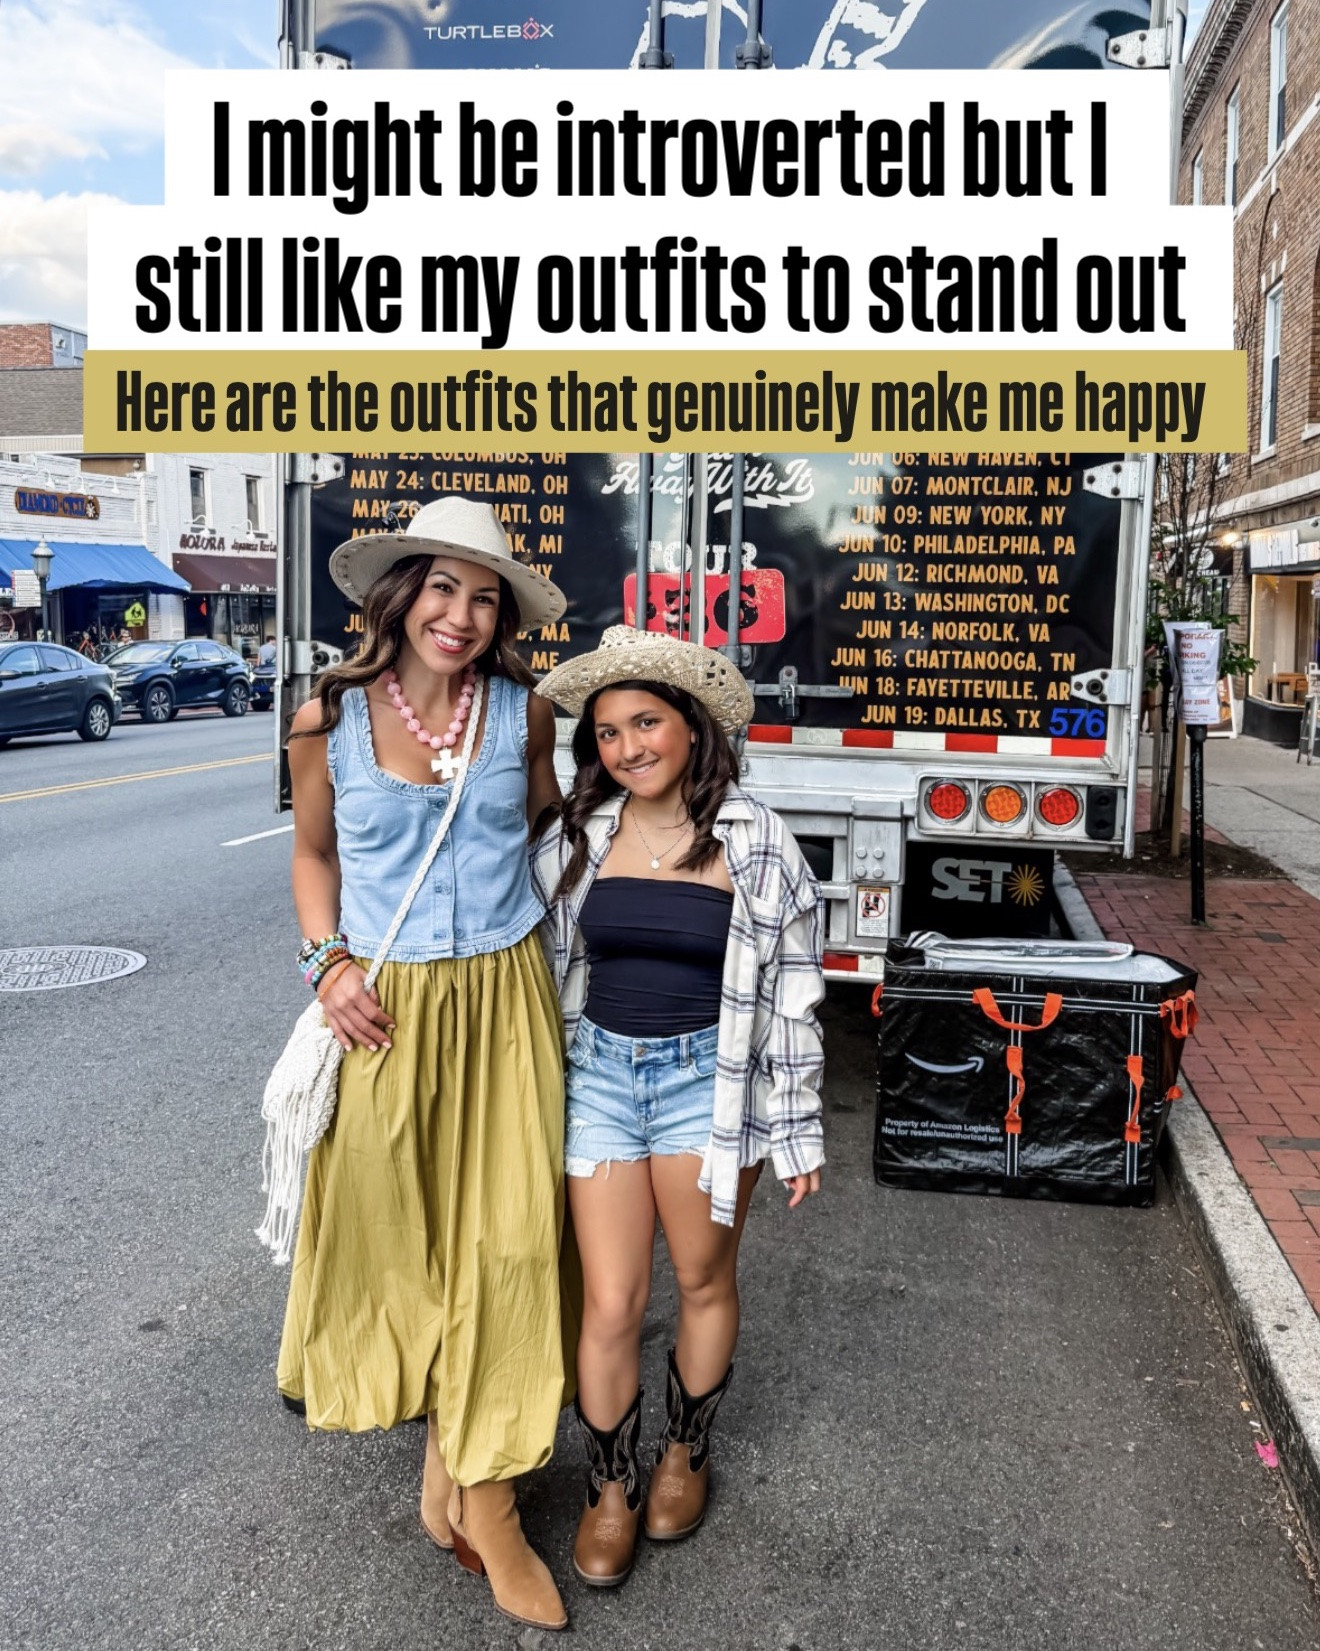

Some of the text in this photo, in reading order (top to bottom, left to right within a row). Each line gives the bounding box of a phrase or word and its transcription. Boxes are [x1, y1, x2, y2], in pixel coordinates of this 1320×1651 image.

[423, 19, 554, 40] TURTLEBOX
[848, 453, 883, 466] JUN
[892, 453, 919, 466] 06:
[928, 453, 968, 466] NEW
[978, 453, 1042, 467] HAVEN,
[350, 470, 568, 495] MAY 24: CLEVELAND, OH
[848, 475, 1072, 497] JUN 07: MONTCLAIR, NJ
[352, 499, 421, 518] MAY 26
[539, 504, 564, 525] OH
[851, 506, 1066, 526] JUN 09: NEW YORK, NY
[539, 534, 562, 554] MI
[838, 534, 1076, 556] JUN 10: PHILADELPHIA, PA
[852, 562, 1059, 585] JUN 12: RICHMOND, VA
[839, 591, 1070, 614] JUN 13: WASHINGTON, DC
[344, 614, 364, 633] JU
[540, 623, 571, 642] MA
[856, 620, 1050, 643] JUN 14: NORFOLK, VA
[831, 647, 1076, 672] JUN 16: CHATTANOOGA, TN
[875, 677, 900, 696] 18:
[906, 677, 1038, 700] FAYETTEVILLE,
[1046, 682, 1071, 701] AR
[861, 705, 1105, 738] JUN 19: DALLAS, TX 576
[931, 857, 1012, 903] SET
[881, 1125, 1003, 1143] Not for resale/unauthorized use
[885, 1117, 919, 1129] Property
[930, 1121, 962, 1131] Amazon
[964, 1123, 1000, 1133] Logistics
